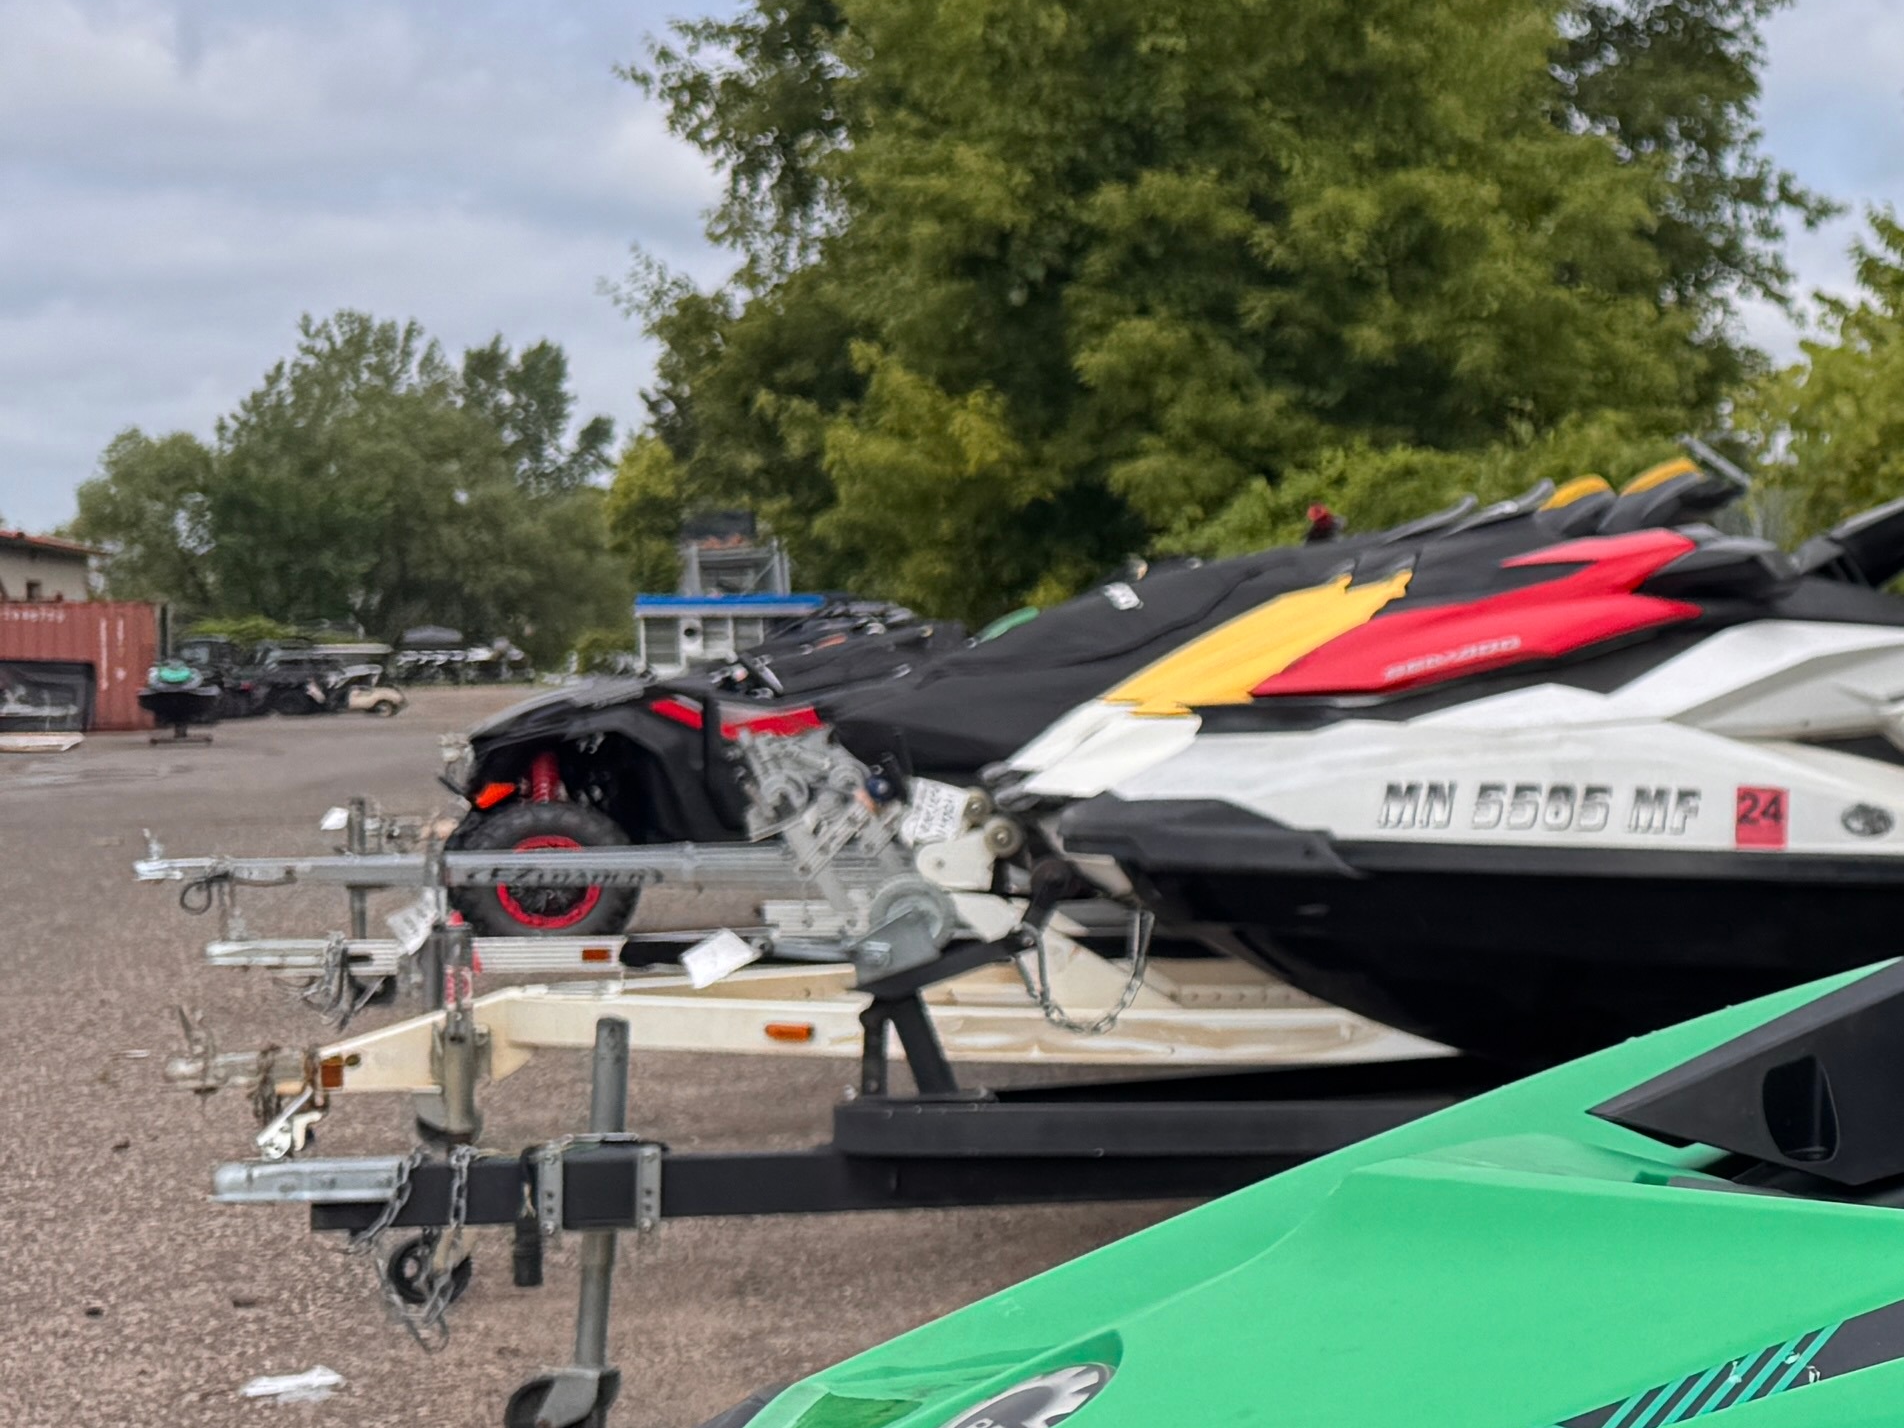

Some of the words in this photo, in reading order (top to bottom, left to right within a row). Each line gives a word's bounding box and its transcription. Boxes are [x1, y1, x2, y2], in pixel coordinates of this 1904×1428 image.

[1378, 780, 1457, 829] MN
[1625, 784, 1701, 835] MF
[1737, 791, 1783, 825] 24
